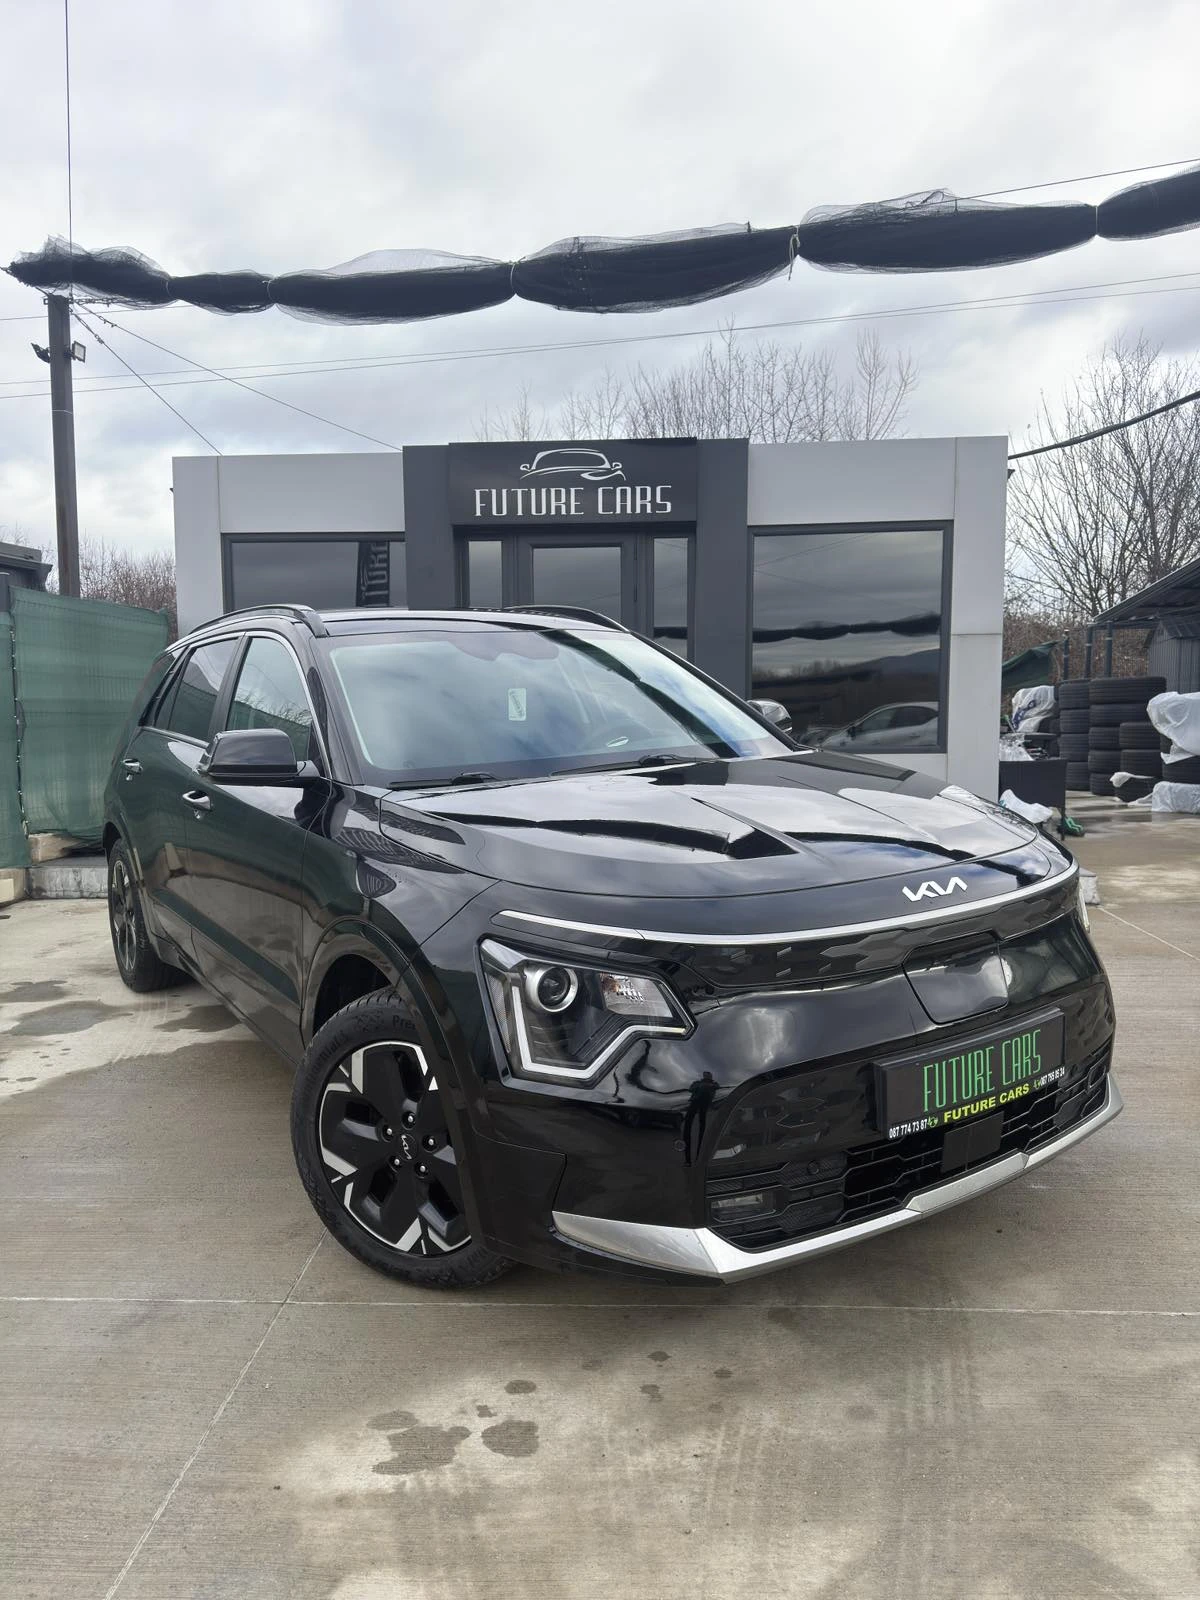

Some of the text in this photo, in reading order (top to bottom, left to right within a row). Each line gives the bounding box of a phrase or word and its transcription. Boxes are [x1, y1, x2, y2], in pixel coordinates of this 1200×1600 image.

[473, 485, 672, 517] FUTURE CARS
[902, 876, 968, 902] KIA
[923, 1029, 1041, 1112] FUTURE CARS
[943, 1096, 996, 1123] FUTURE
[999, 1083, 1031, 1104] CARS
